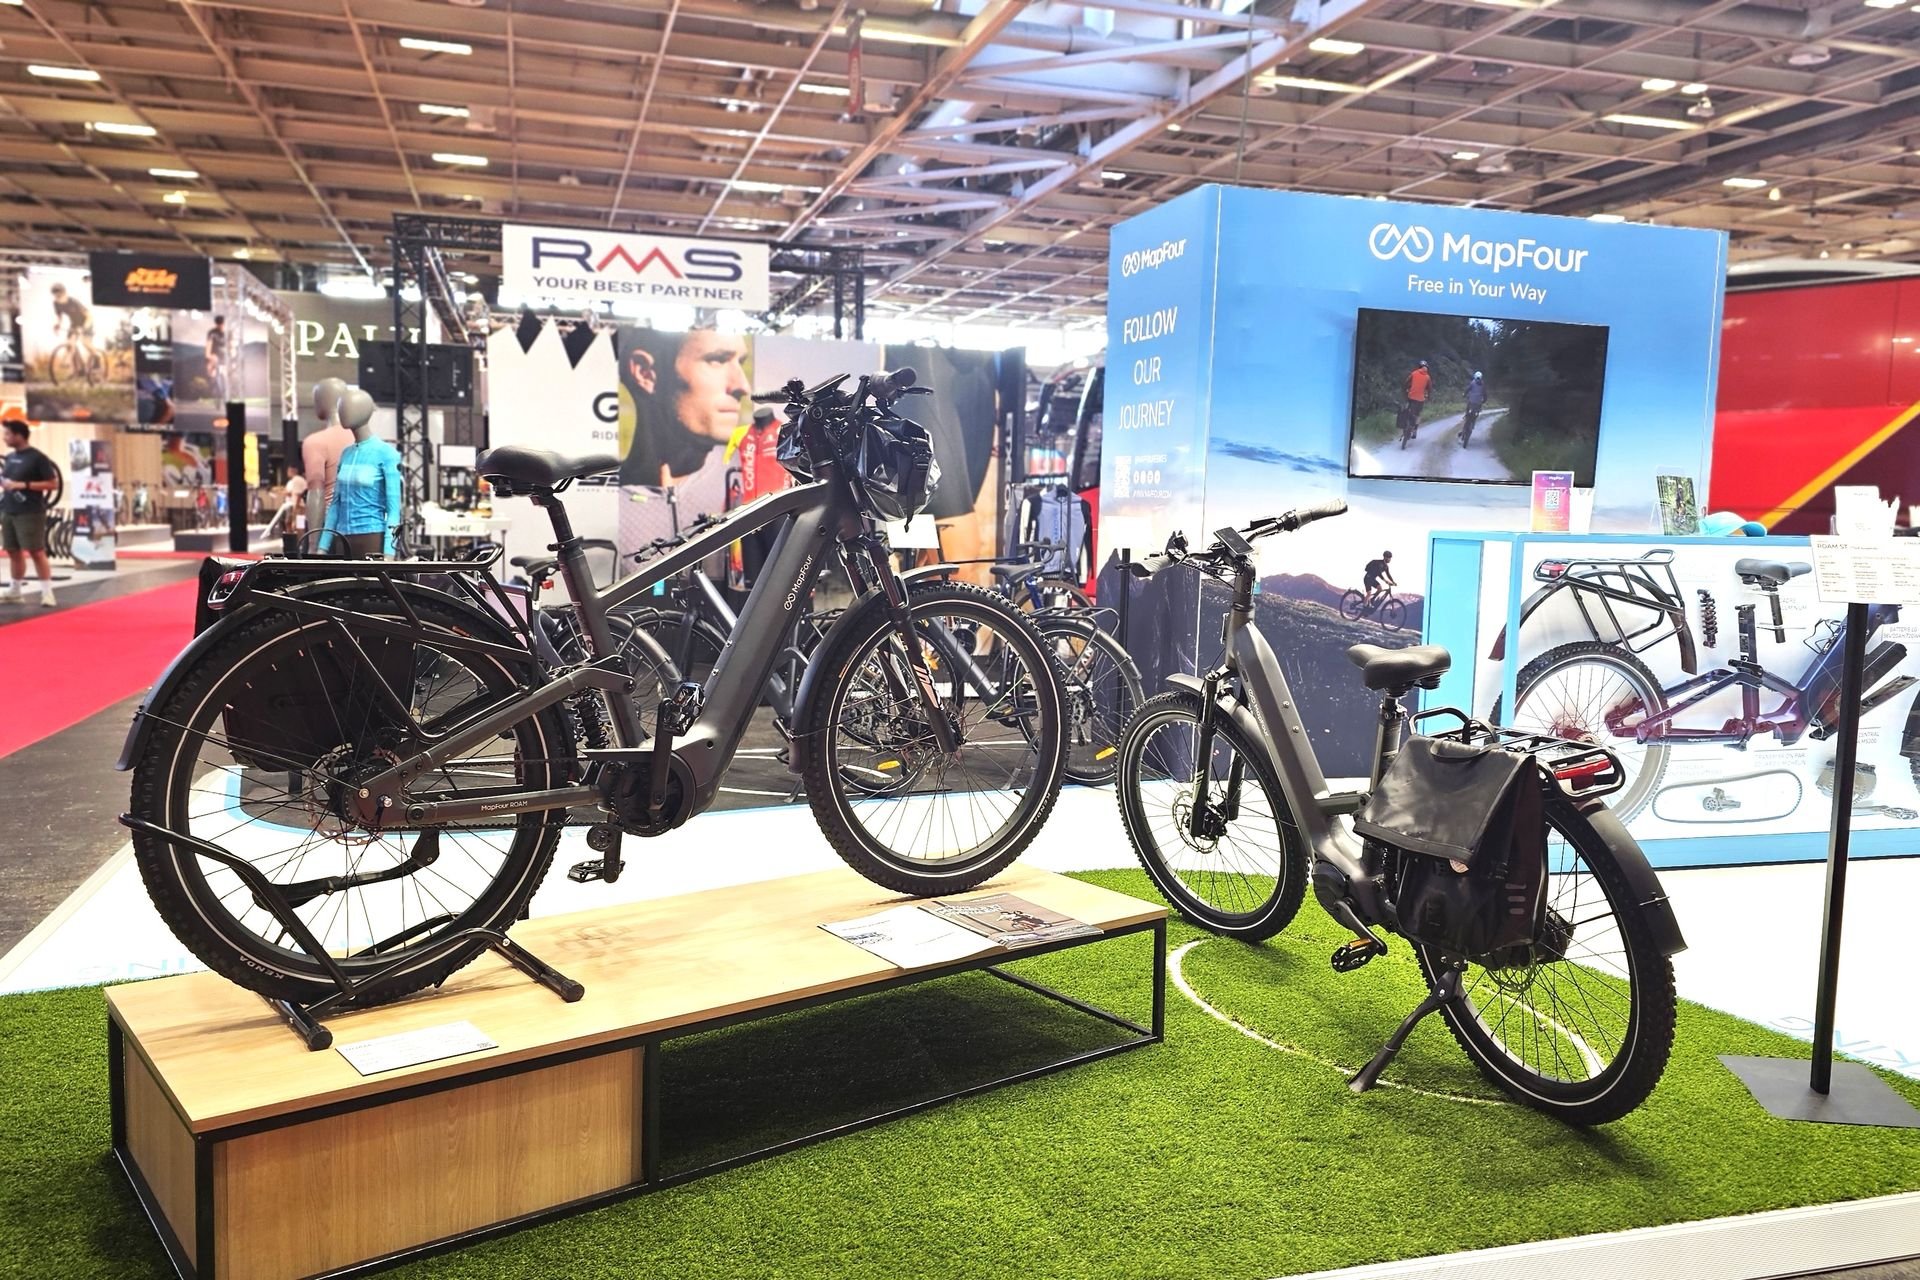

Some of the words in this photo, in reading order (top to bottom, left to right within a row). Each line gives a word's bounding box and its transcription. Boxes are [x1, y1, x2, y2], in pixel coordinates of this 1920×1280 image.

[532, 237, 743, 282] RMS
[1141, 239, 1187, 270] MapFour
[1442, 231, 1589, 273] MapFour
[533, 276, 588, 291] YOUR
[594, 280, 645, 295] BEST
[651, 284, 743, 301] PARTNER
[1408, 274, 1444, 293] Free
[1449, 278, 1463, 294] in
[1469, 279, 1506, 297] Your
[1511, 282, 1547, 304] Way
[1123, 306, 1178, 345] FOLLOW
[1134, 356, 1162, 385] OUR
[1118, 400, 1175, 430] JOURNEY
[744, 443, 756, 491] Cofidis
[791, 554, 813, 593] MapFour
[240, 955, 284, 979] KENDA
